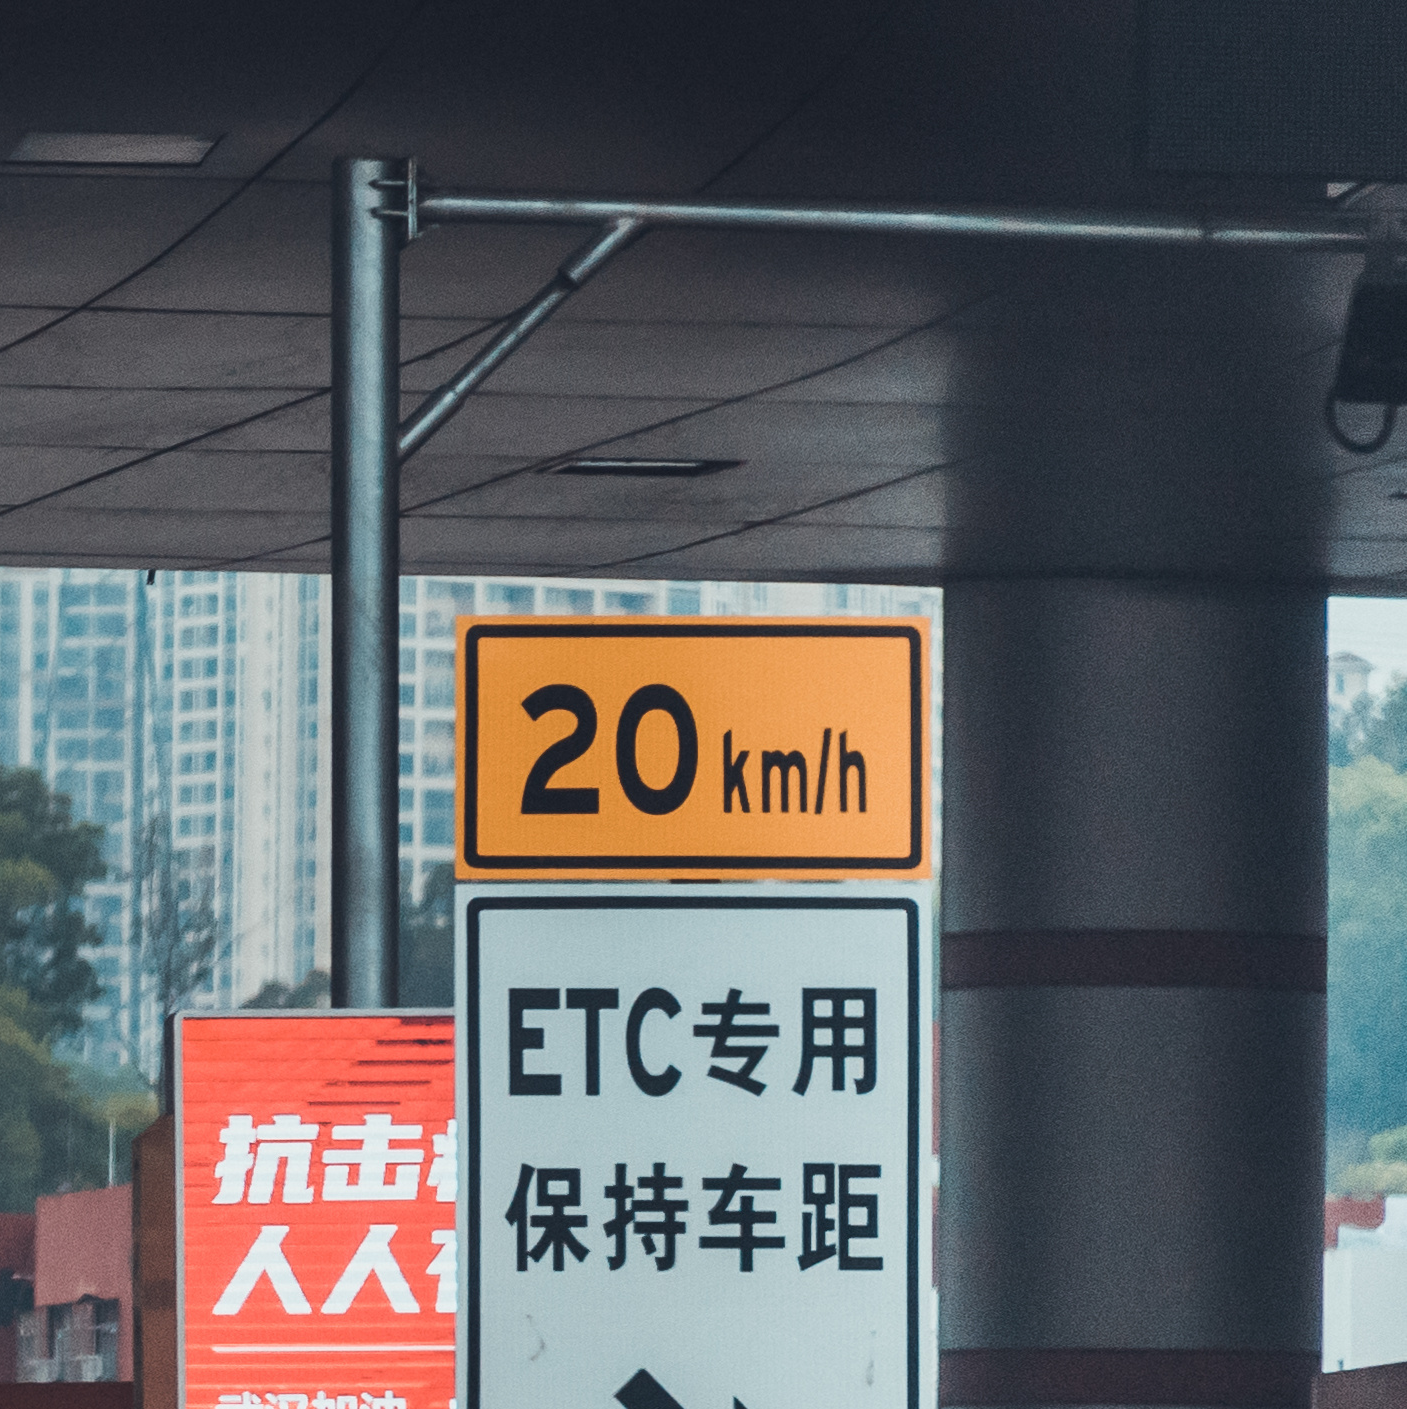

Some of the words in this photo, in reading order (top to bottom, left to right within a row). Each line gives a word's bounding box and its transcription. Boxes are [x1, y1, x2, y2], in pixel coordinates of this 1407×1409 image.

[520, 683, 699, 816] 20
[723, 727, 867, 815] km/h
[508, 986, 878, 1097] ETC专用
[504, 1161, 884, 1273] 保持车距
